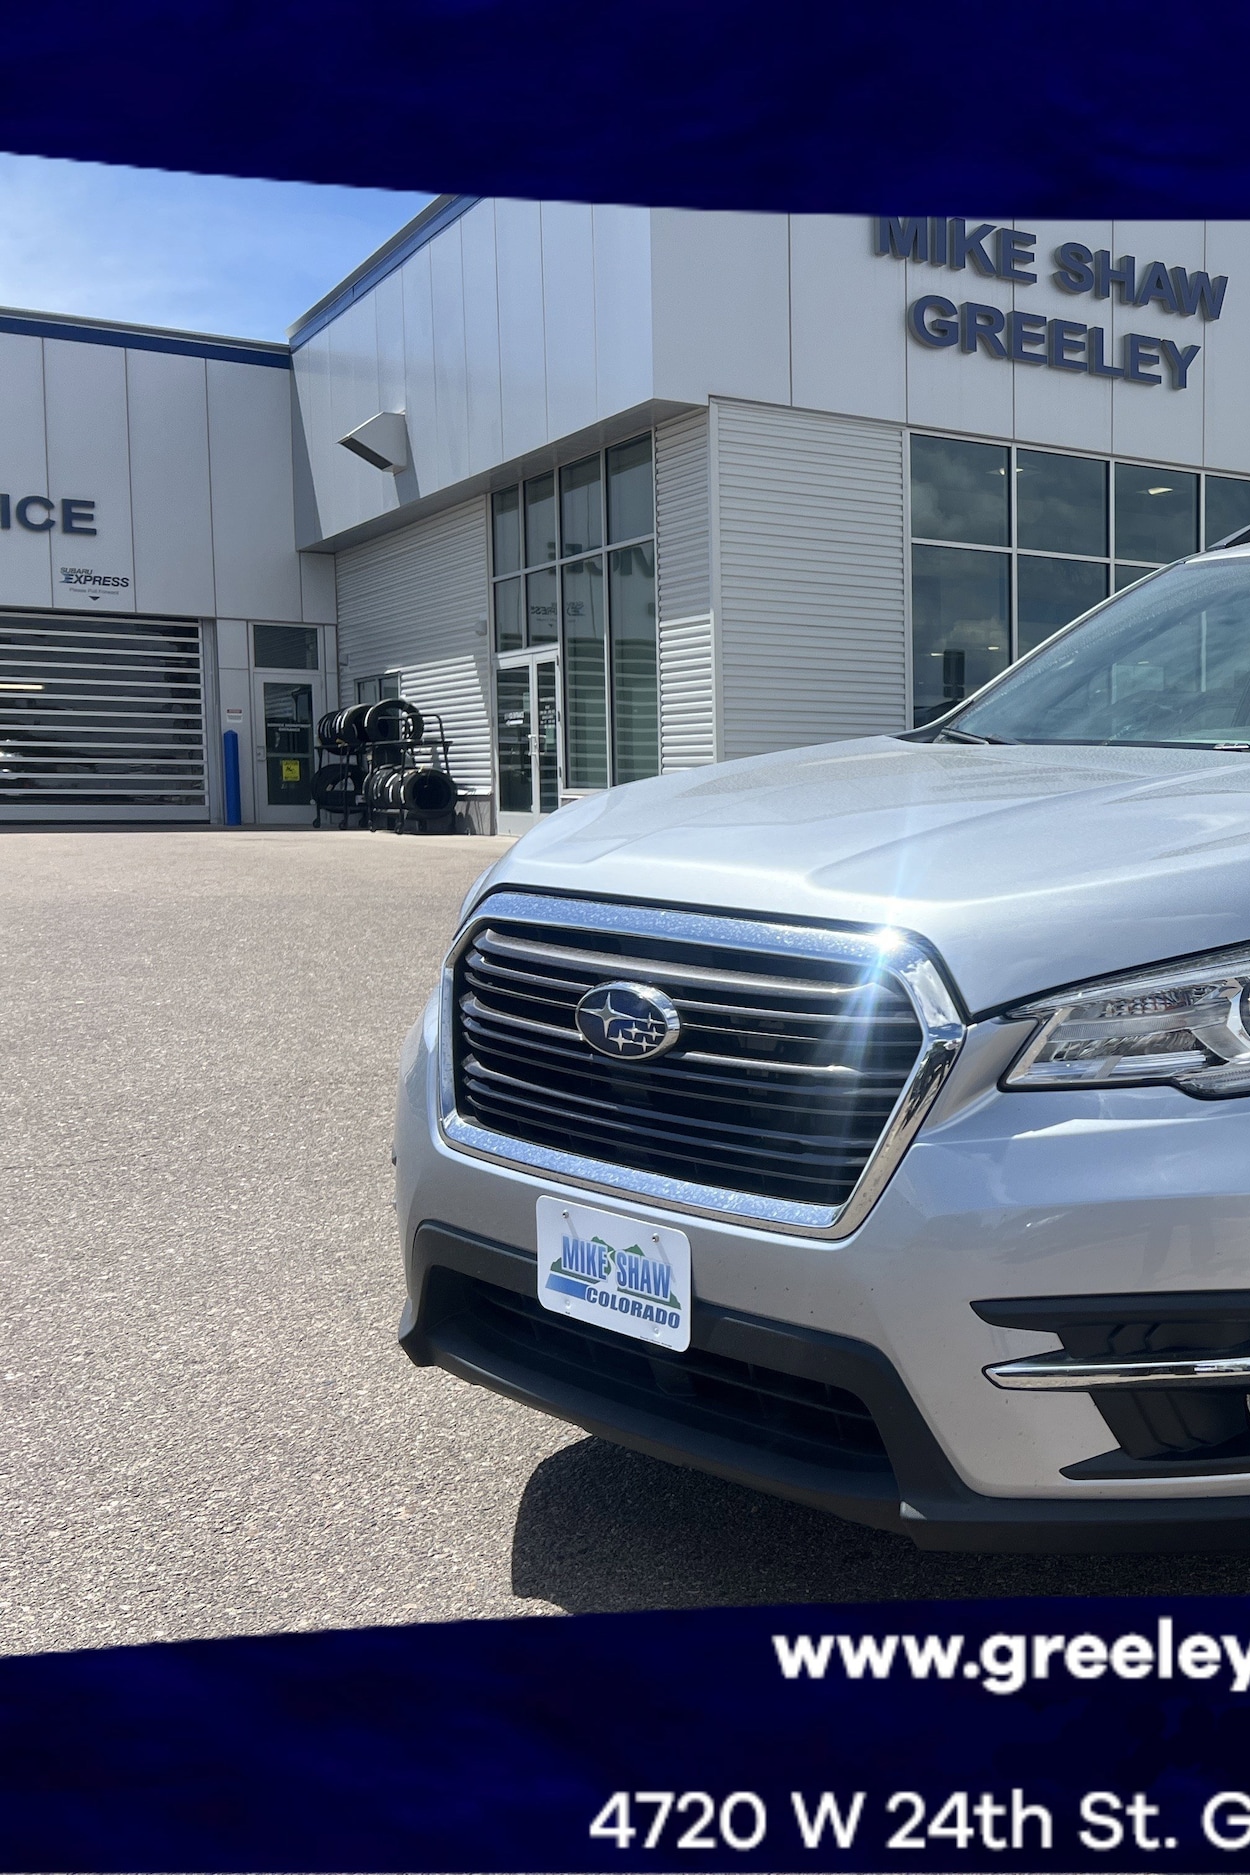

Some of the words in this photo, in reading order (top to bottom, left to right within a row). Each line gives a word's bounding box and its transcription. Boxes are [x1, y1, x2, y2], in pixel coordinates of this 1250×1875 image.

[874, 216, 1038, 284] MIKE
[1052, 242, 1229, 321] SHAW
[908, 294, 1201, 390] GREELEY
[0, 493, 98, 537] ICE
[60, 574, 130, 587] EXPRESS
[61, 567, 93, 575] SUBARU
[563, 1235, 607, 1281] MIKE
[617, 1251, 671, 1299] SHAW
[586, 1287, 681, 1330] COLORADO
